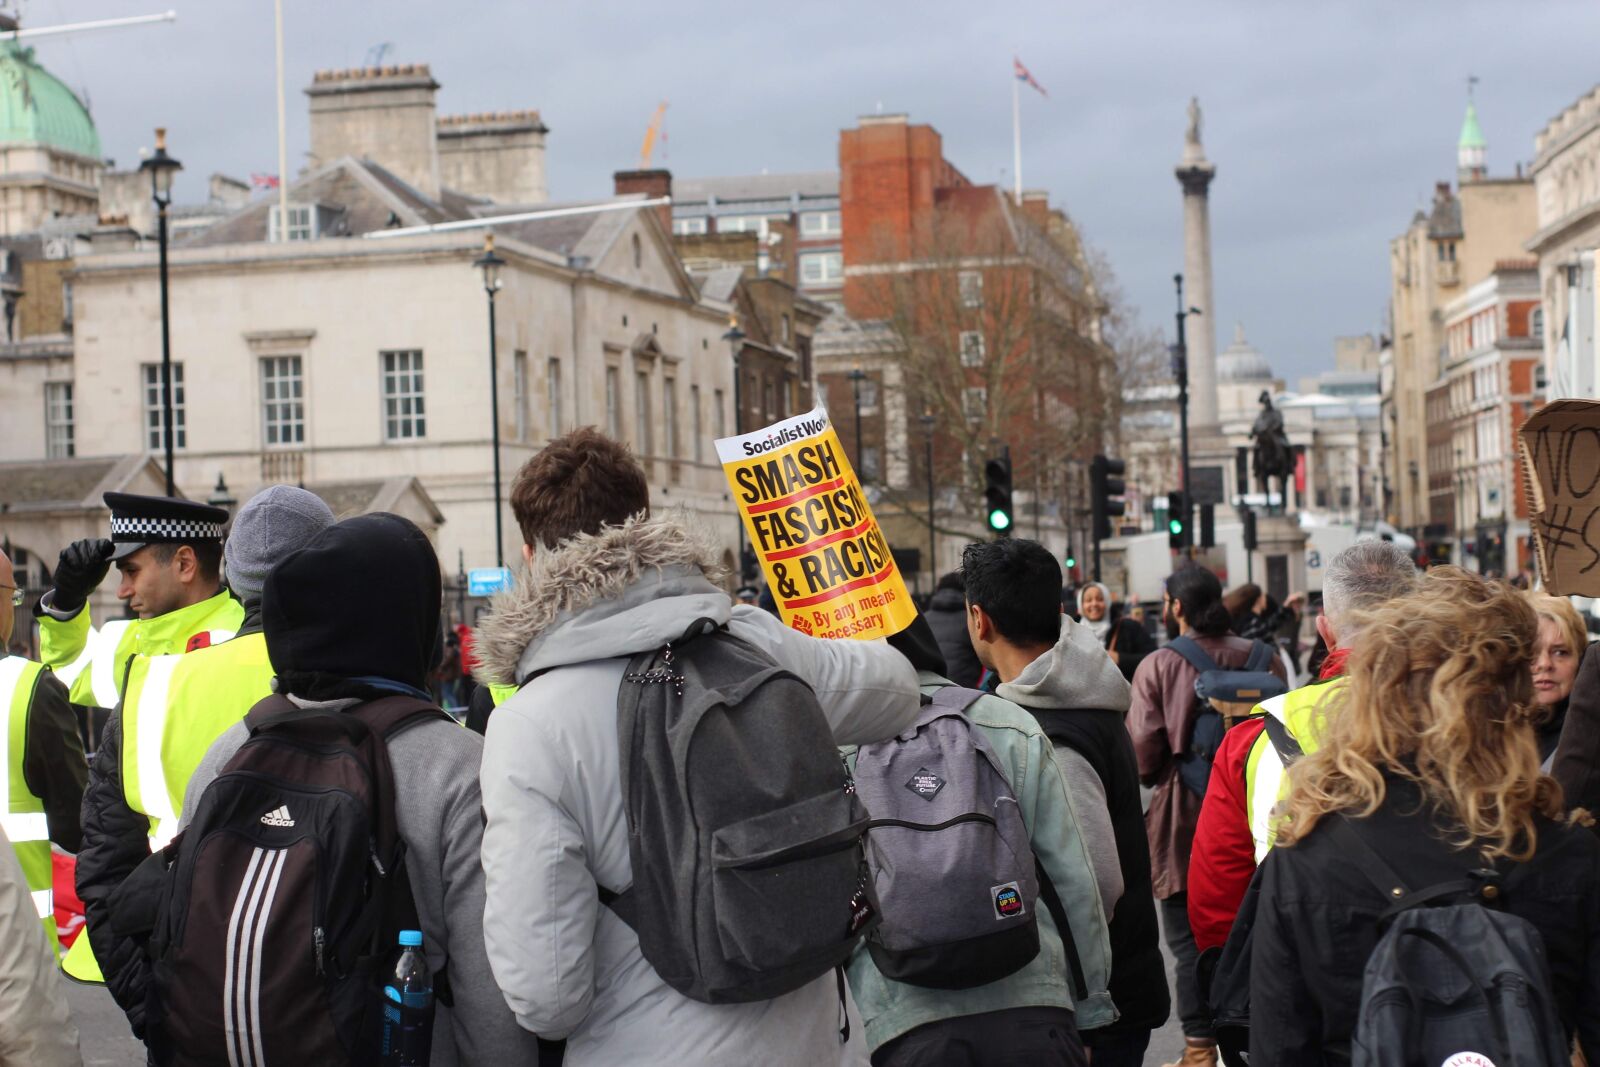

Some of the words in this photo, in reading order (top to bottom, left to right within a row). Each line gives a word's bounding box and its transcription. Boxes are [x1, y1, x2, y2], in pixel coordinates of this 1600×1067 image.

[743, 428, 804, 456] Socialist
[735, 439, 841, 504] SMASH
[751, 480, 867, 552] FASCISM
[772, 562, 800, 599] &
[799, 522, 890, 594] RACISM
[812, 611, 830, 629] By
[834, 603, 856, 621] any
[859, 588, 896, 611] means
[820, 613, 885, 640] necessary
[260, 816, 295, 827] adidas
[999, 899, 1009, 907] UP
